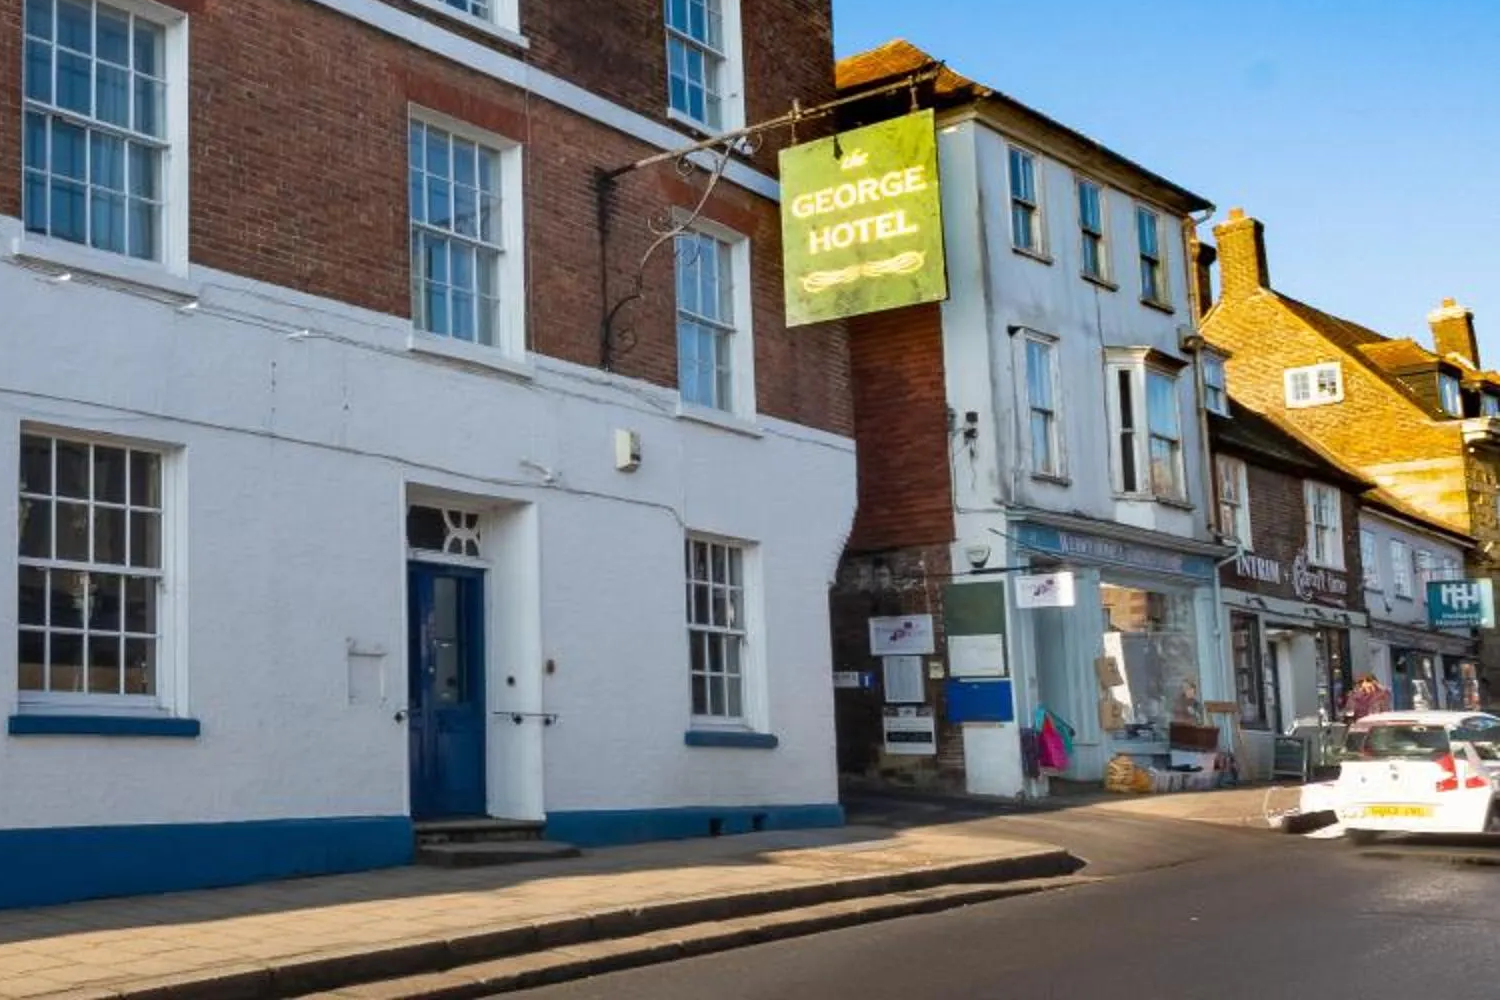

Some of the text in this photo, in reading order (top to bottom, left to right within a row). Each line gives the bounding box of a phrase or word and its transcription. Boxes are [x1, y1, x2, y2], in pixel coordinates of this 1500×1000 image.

[841, 149, 869, 170] the
[791, 165, 927, 219] GEORGE
[808, 208, 920, 255] HOTEL
